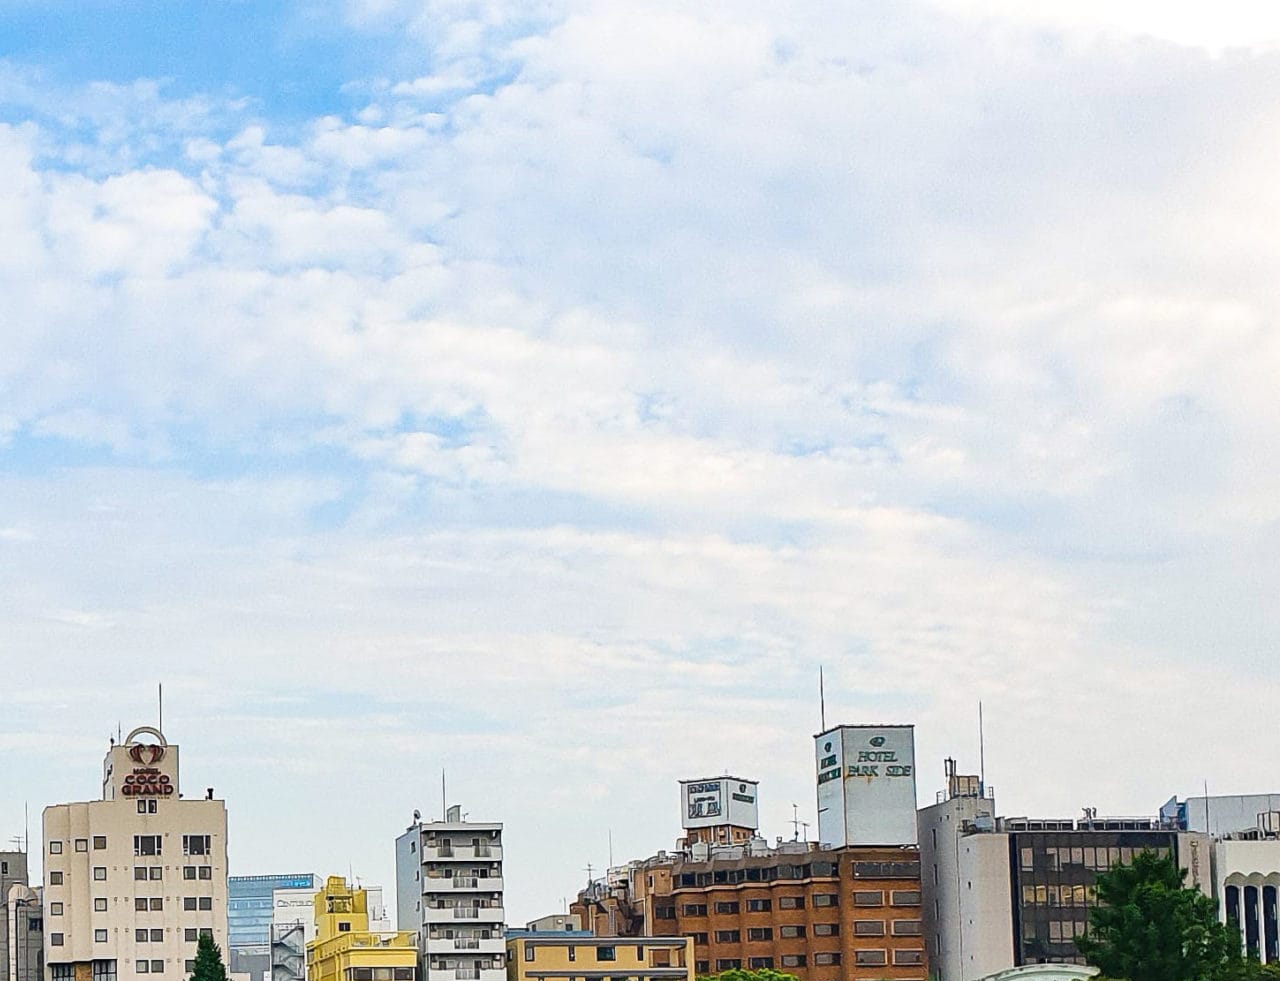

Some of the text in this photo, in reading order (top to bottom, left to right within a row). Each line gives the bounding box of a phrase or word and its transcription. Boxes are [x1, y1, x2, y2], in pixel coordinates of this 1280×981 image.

[858, 751, 898, 762] HOTEL
[847, 765, 878, 777] PARK
[885, 765, 912, 777] SIDE
[125, 775, 170, 785] COCO
[121, 784, 174, 796] GRAND
